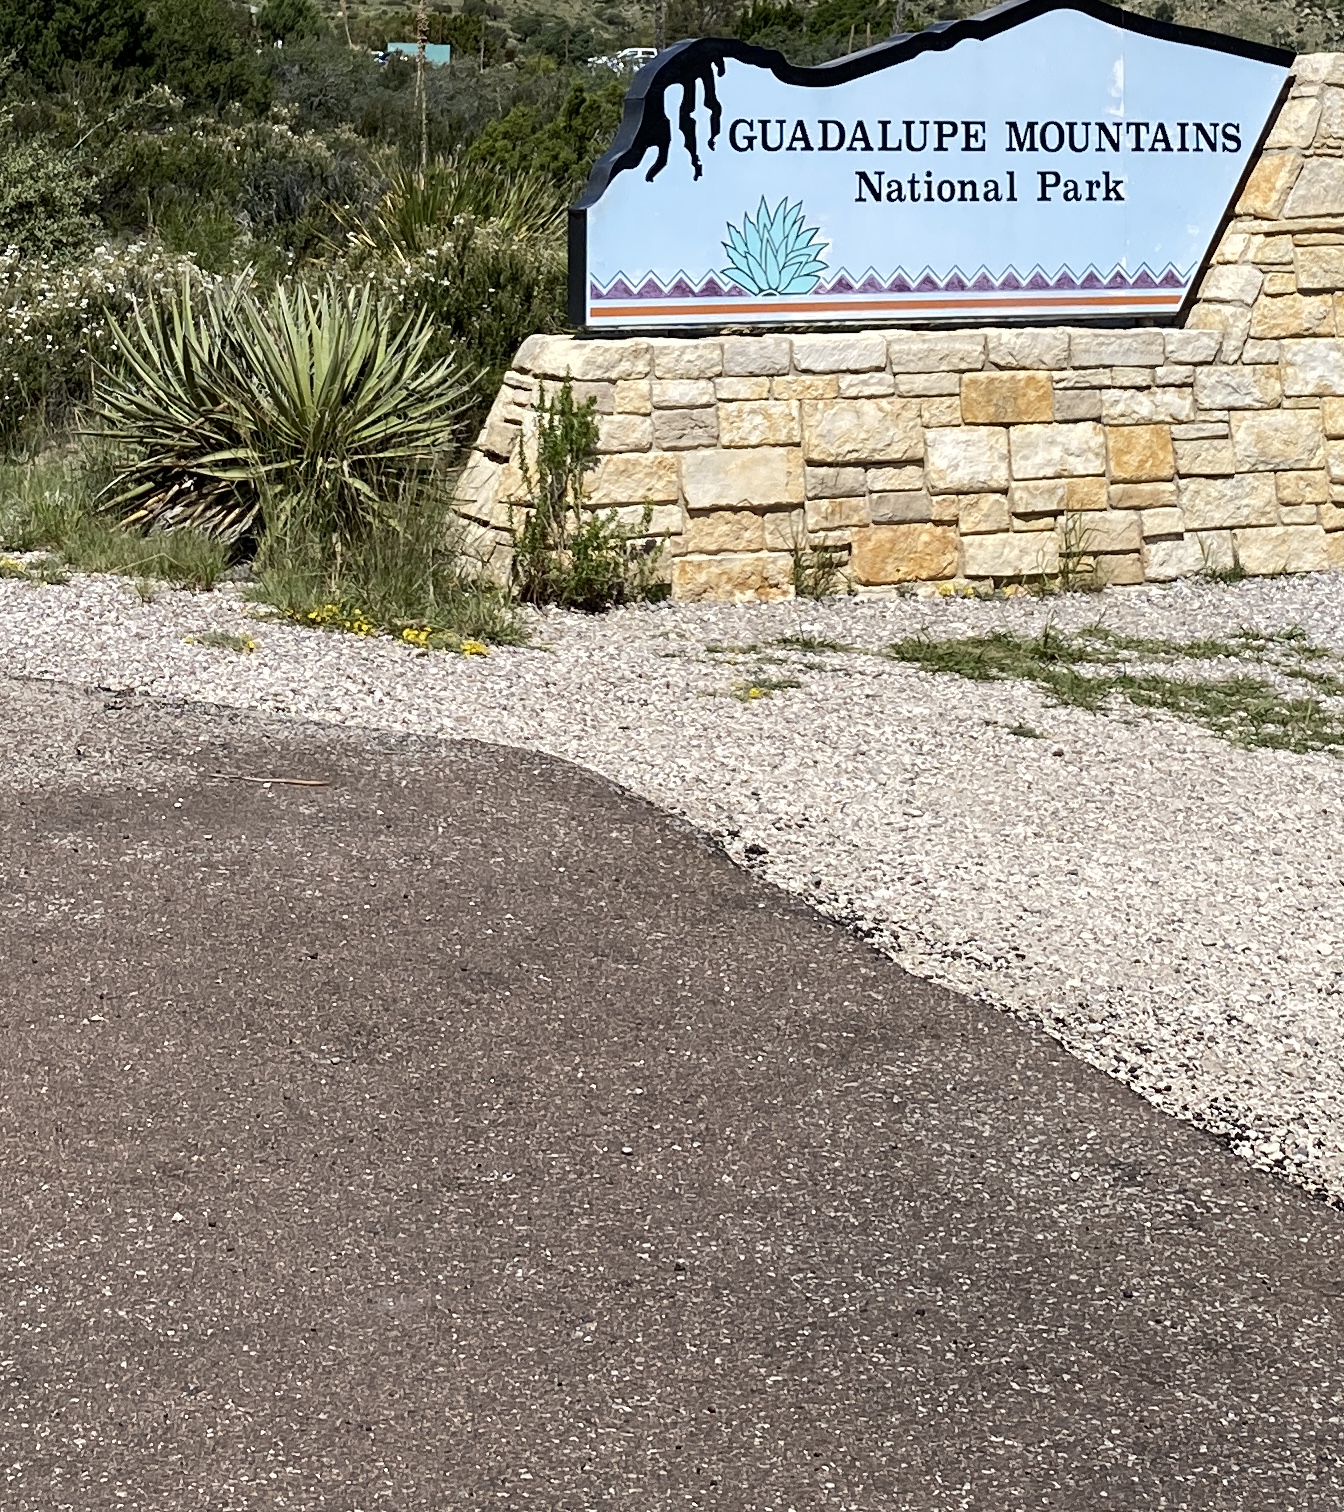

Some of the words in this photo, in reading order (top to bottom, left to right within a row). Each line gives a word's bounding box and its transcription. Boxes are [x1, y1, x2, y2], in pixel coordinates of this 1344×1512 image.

[728, 119, 987, 154] GUADALUPE
[1004, 119, 1243, 154] MOUNTAINS
[855, 170, 1018, 203] National
[1036, 171, 1125, 203] Park
